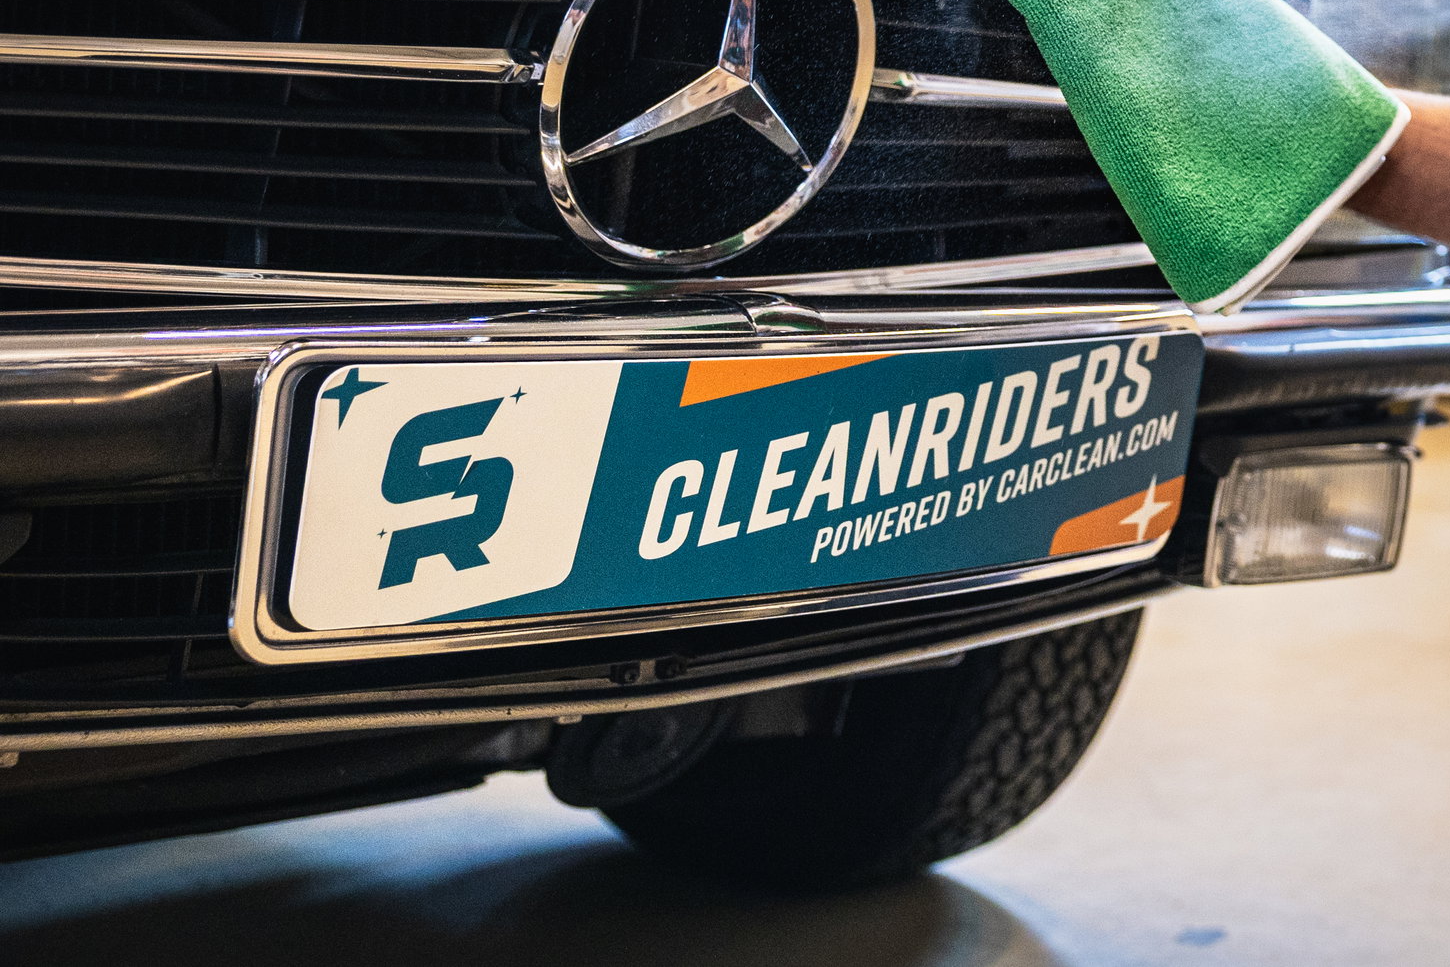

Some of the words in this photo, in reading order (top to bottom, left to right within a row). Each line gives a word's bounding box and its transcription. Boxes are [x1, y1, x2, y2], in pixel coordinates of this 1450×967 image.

[638, 336, 1161, 560] CLEANRIDERS
[810, 491, 951, 564] POWERED
[956, 475, 995, 518] BY
[996, 410, 1179, 504] CARCLEAN.COM
